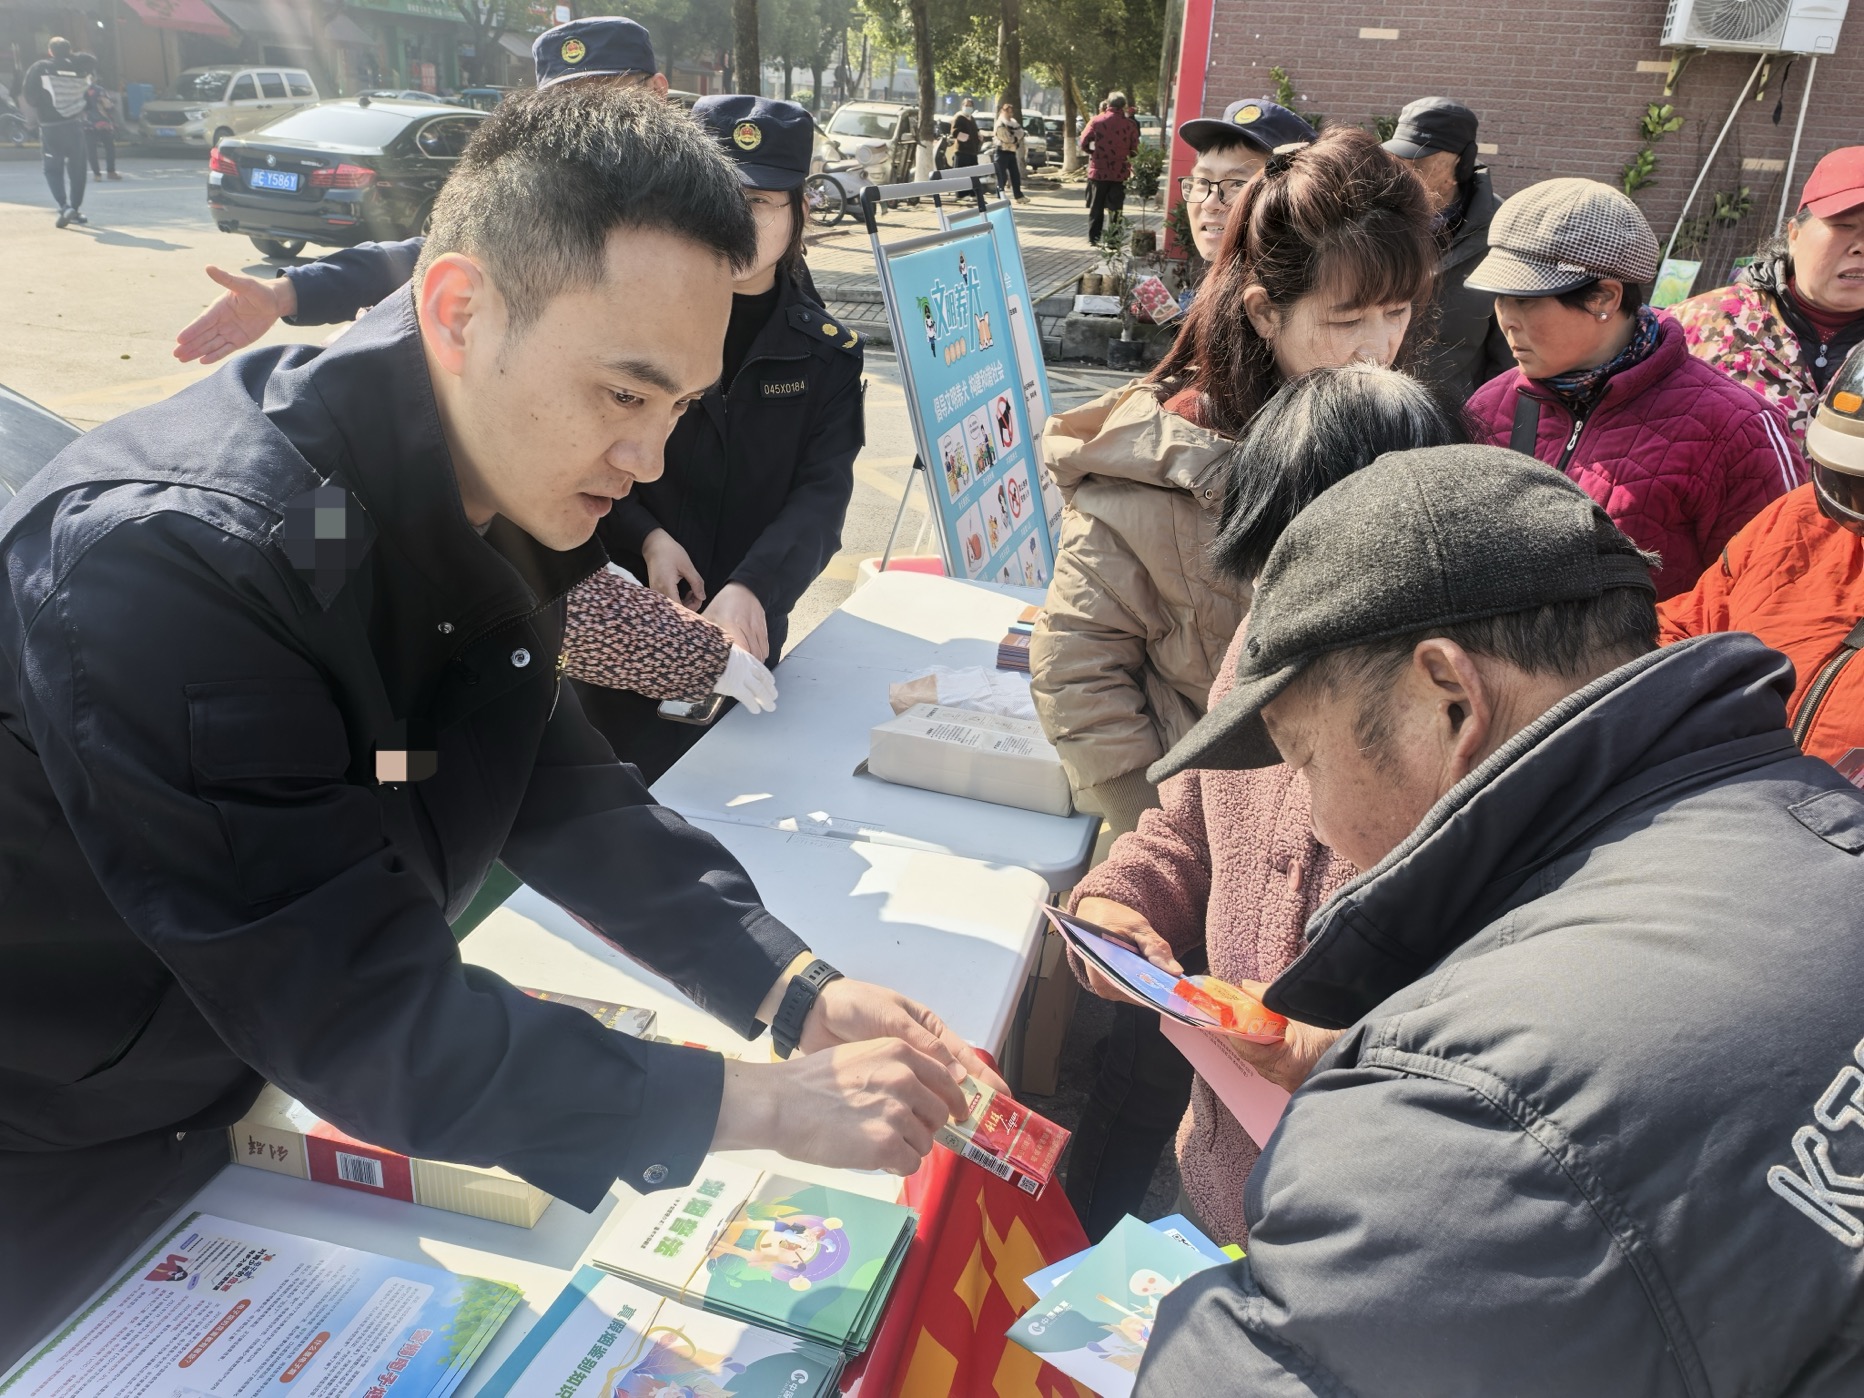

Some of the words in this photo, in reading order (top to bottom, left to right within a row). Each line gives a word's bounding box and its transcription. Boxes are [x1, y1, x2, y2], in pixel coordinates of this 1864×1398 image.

[930, 264, 982, 353] 文明养犬
[763, 380, 805, 395] 045X0184
[933, 380, 970, 423] 倡导文明养犬
[968, 359, 1005, 398] 构建和谐社会
[999, 1111, 1019, 1136] Liqun
[247, 1134, 289, 1162] 利群
[555, 1304, 637, 1398] 真假烟鉴别知识
